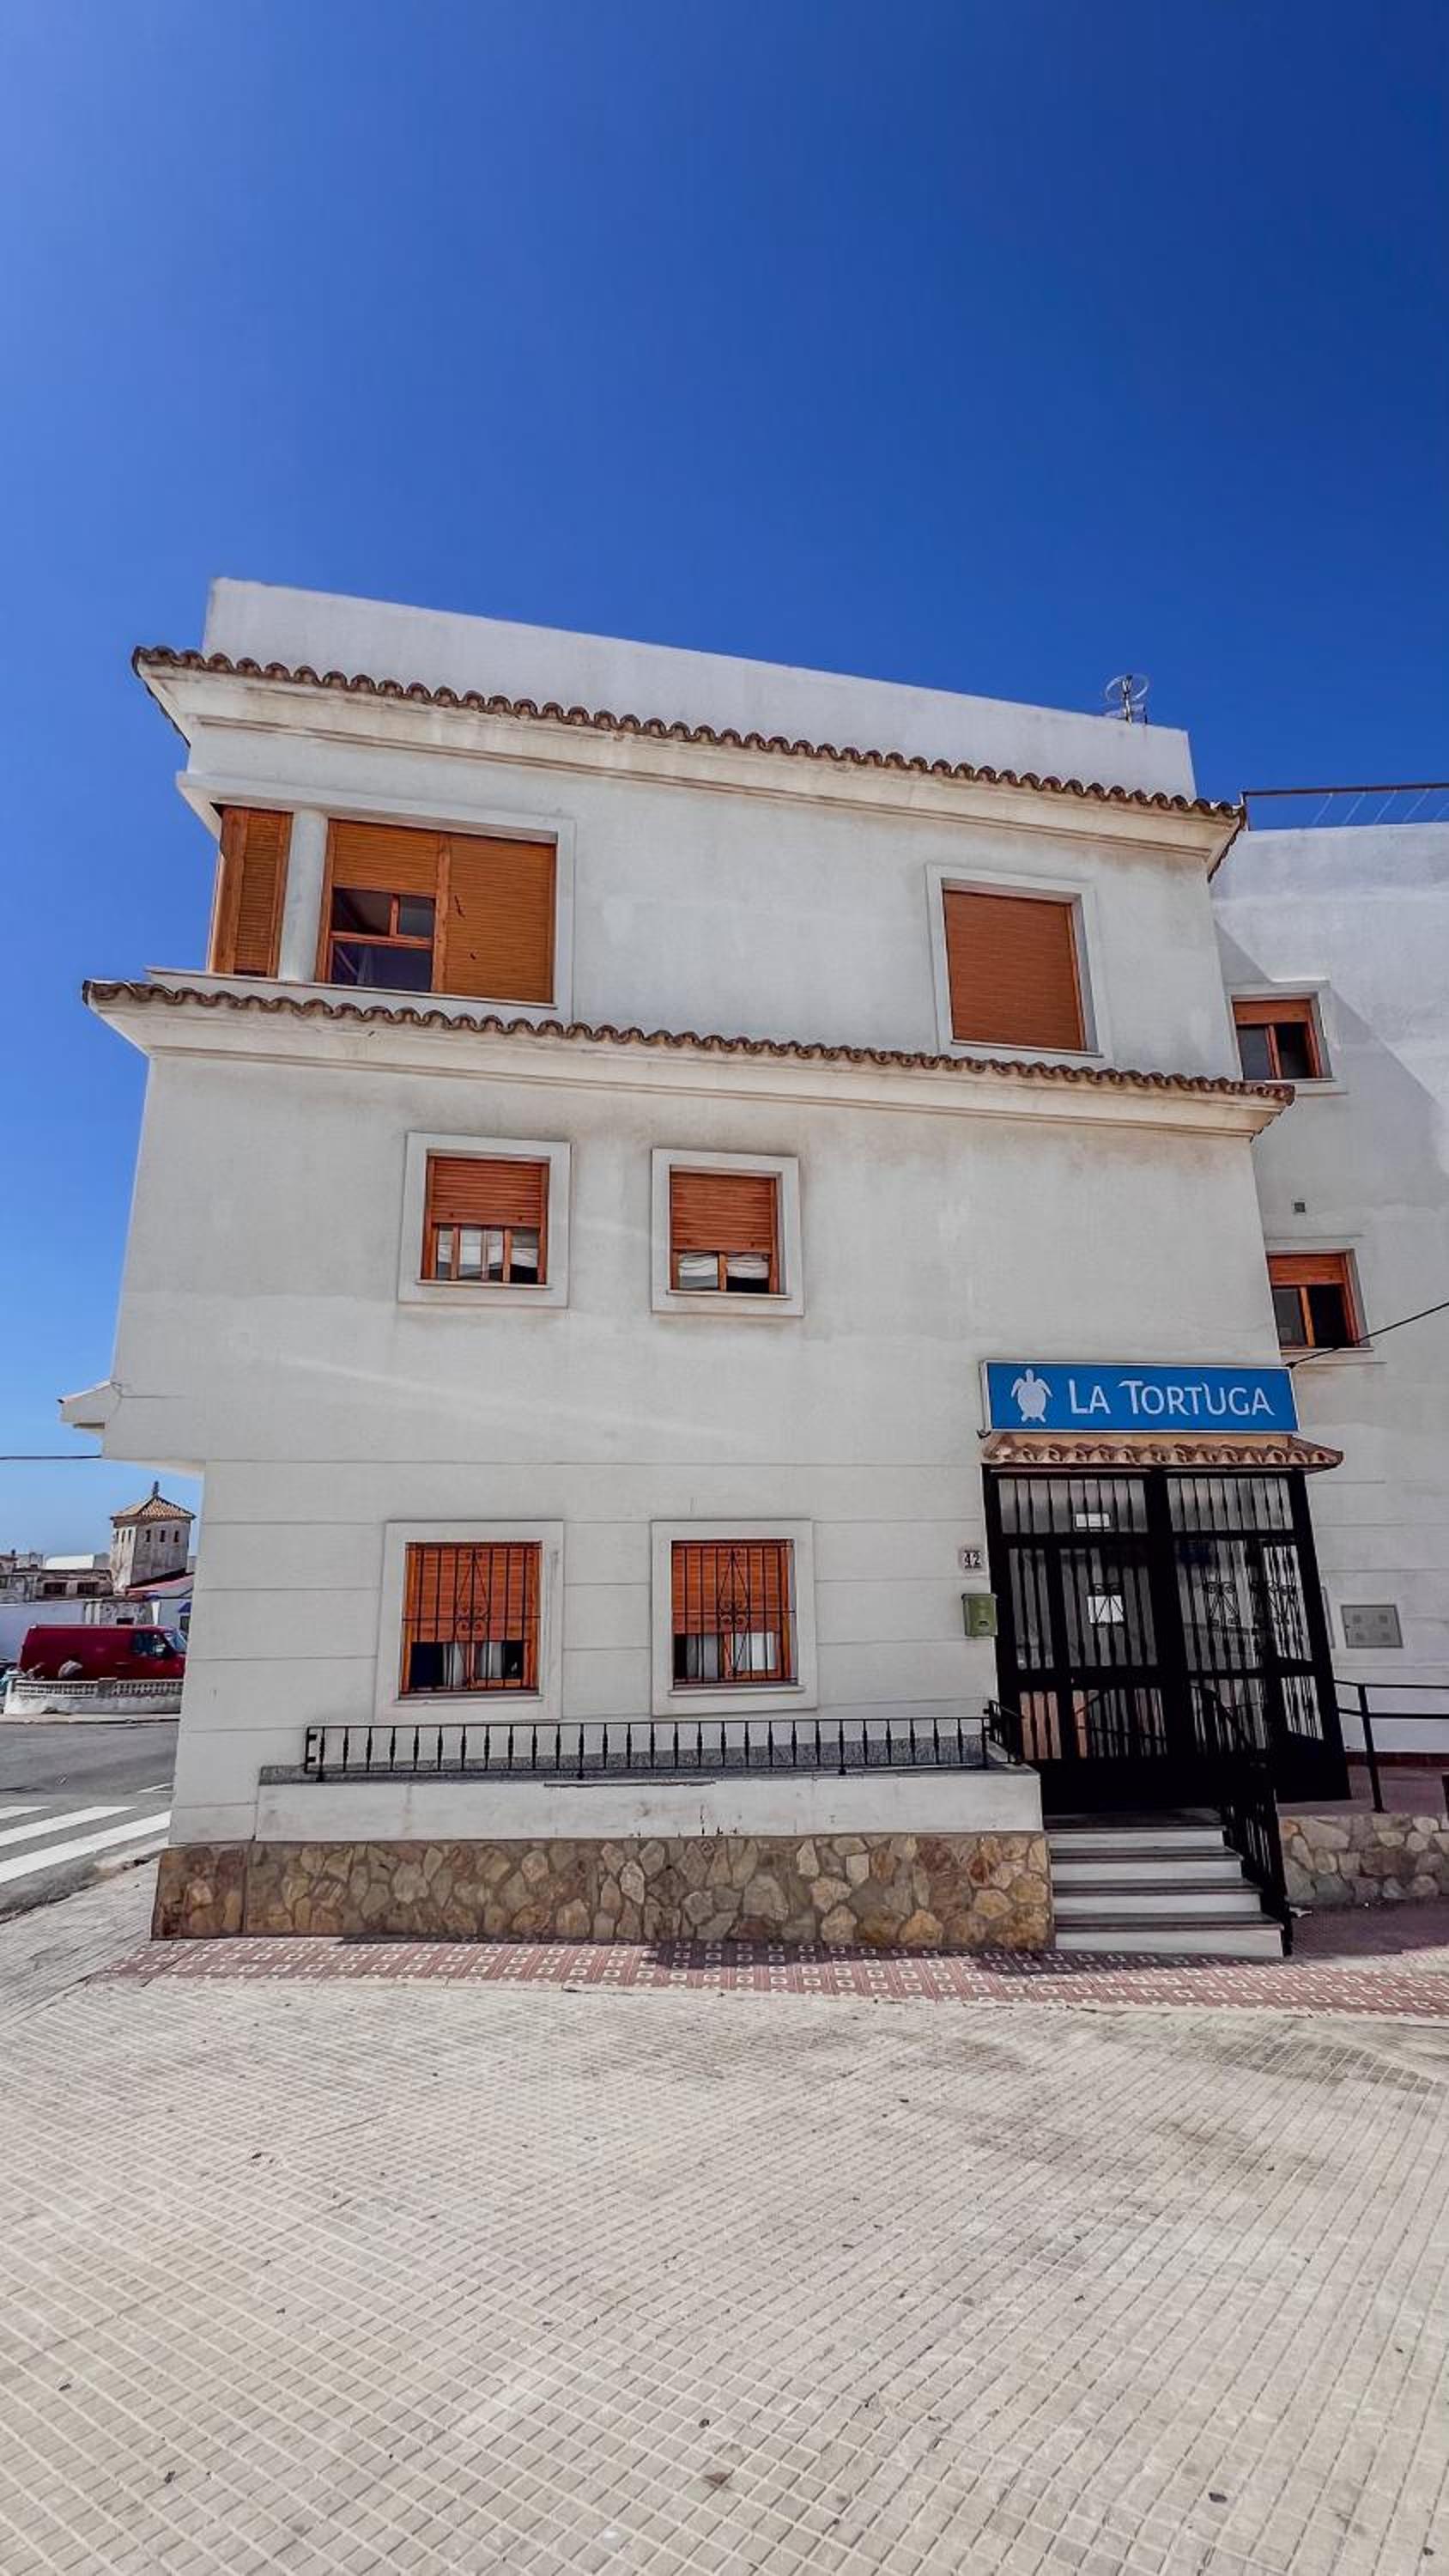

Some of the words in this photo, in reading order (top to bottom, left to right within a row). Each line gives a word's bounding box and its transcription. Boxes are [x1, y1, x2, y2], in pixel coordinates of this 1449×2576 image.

[1069, 1379, 1111, 1414] LA
[1119, 1380, 1275, 1416] TORTUGA
[964, 1552, 980, 1567] 42
